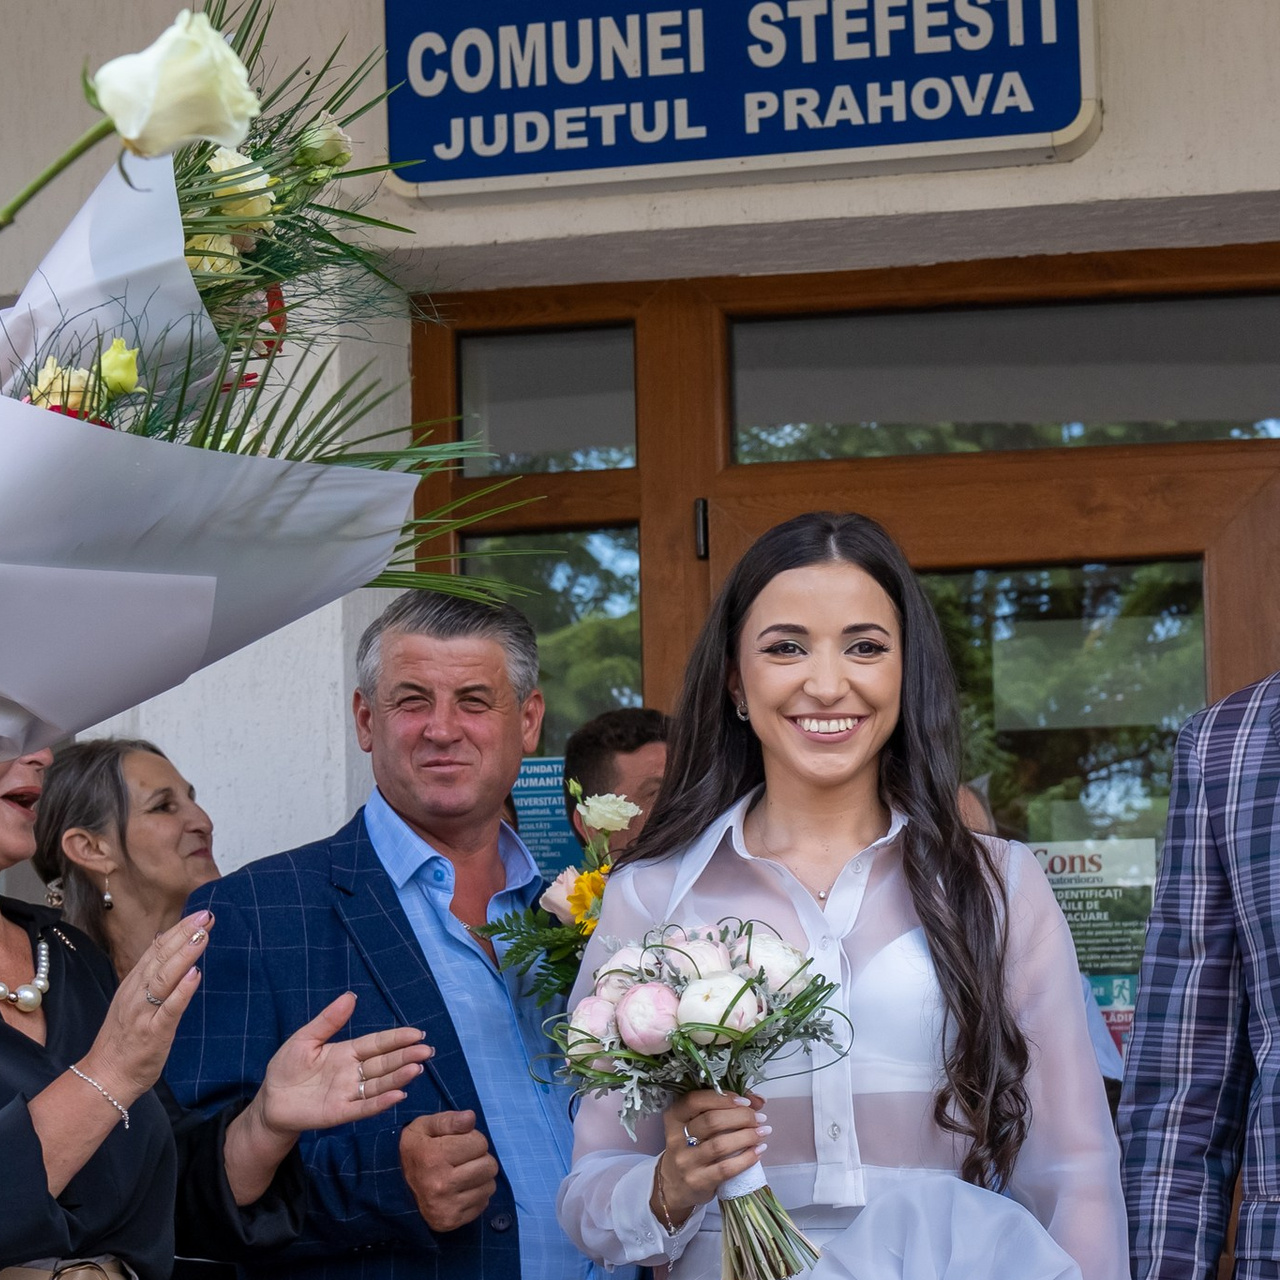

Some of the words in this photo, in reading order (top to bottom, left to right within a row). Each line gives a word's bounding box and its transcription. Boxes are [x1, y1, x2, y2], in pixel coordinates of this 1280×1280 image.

[406, 8, 705, 98] COMUNEI
[746, 0, 1058, 68] STEFESTI
[433, 99, 707, 161] JUDETUL
[744, 71, 1035, 134] PRAHOVA
[1086, 900, 1100, 910] DE
